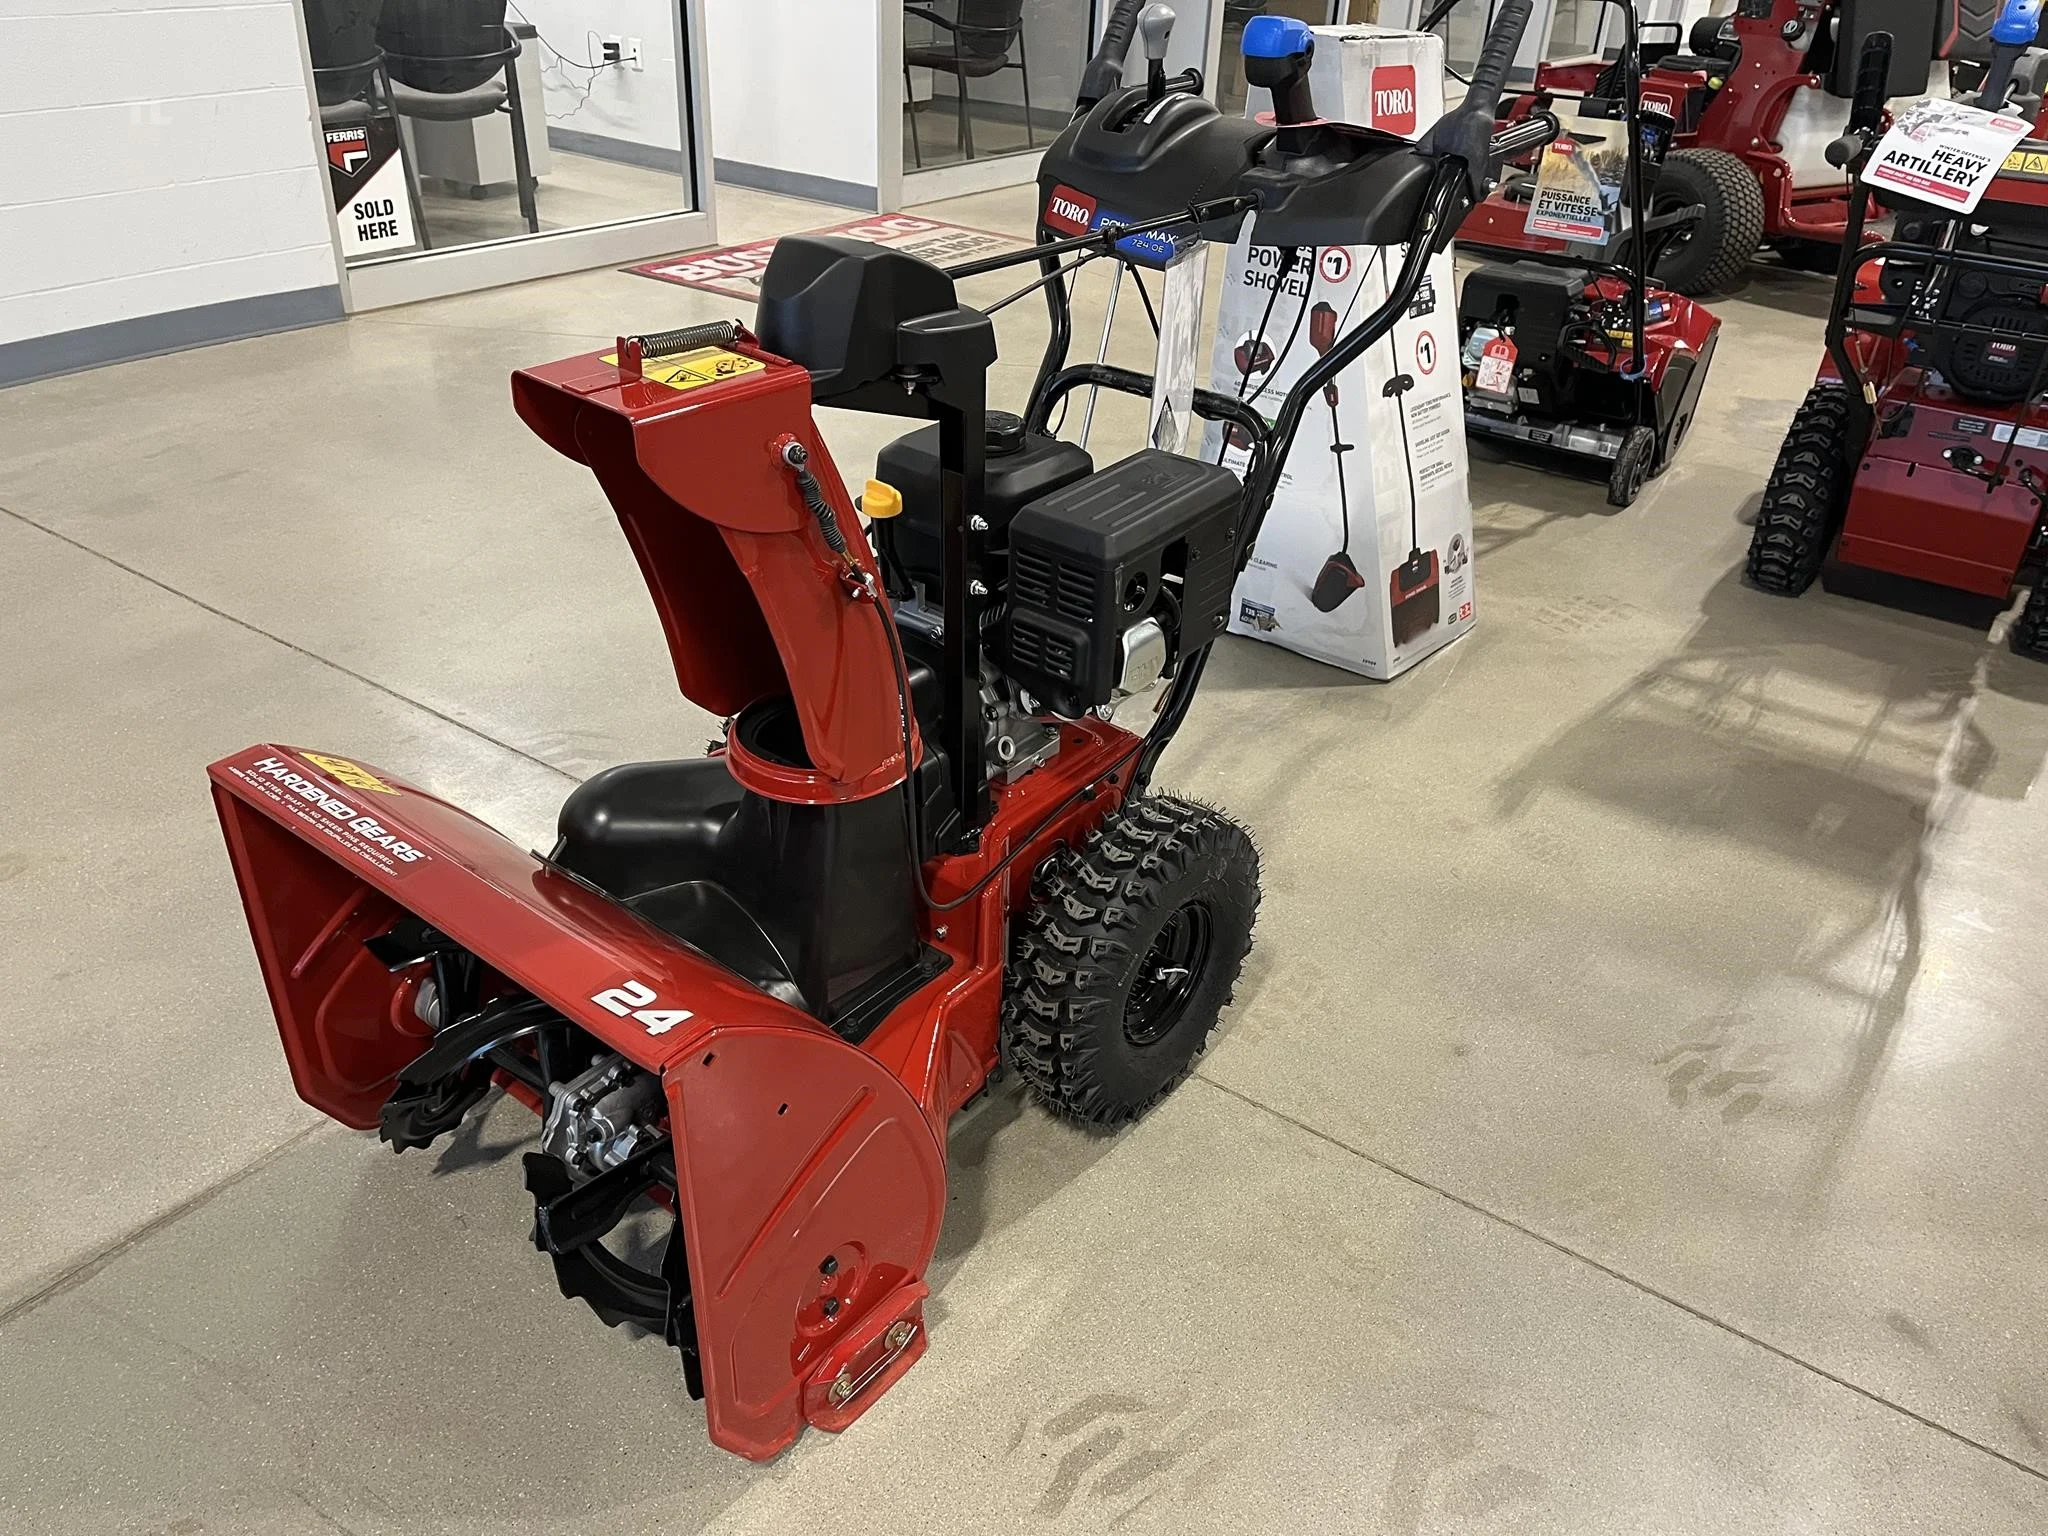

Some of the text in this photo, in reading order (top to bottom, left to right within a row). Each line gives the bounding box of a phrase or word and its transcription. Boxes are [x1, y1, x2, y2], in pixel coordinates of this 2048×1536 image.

[1374, 87, 1413, 117] TORO
[1642, 99, 1669, 113] TORO
[325, 129, 365, 143] FERRIS
[1883, 150, 1980, 188] ARTILLERY
[1931, 149, 1988, 173] HEAVY
[1538, 199, 1599, 217] ET VITESSE
[1540, 190, 1591, 206] PUISSANCE
[353, 199, 394, 221] SOLD
[1051, 196, 1089, 226] TORO
[357, 219, 399, 241] HERE
[1146, 230, 1177, 245] MAX
[1131, 238, 1165, 253] 724 OE
[245, 769, 266, 783] SOLID
[264, 781, 284, 796] STEEL
[283, 794, 306, 808] SHAFT
[310, 811, 321, 819] NO
[342, 831, 360, 843] PINS
[358, 842, 394, 866] REQUIRED
[253, 757, 426, 862] HARDENED GEARS
[590, 979, 695, 1036] 24
